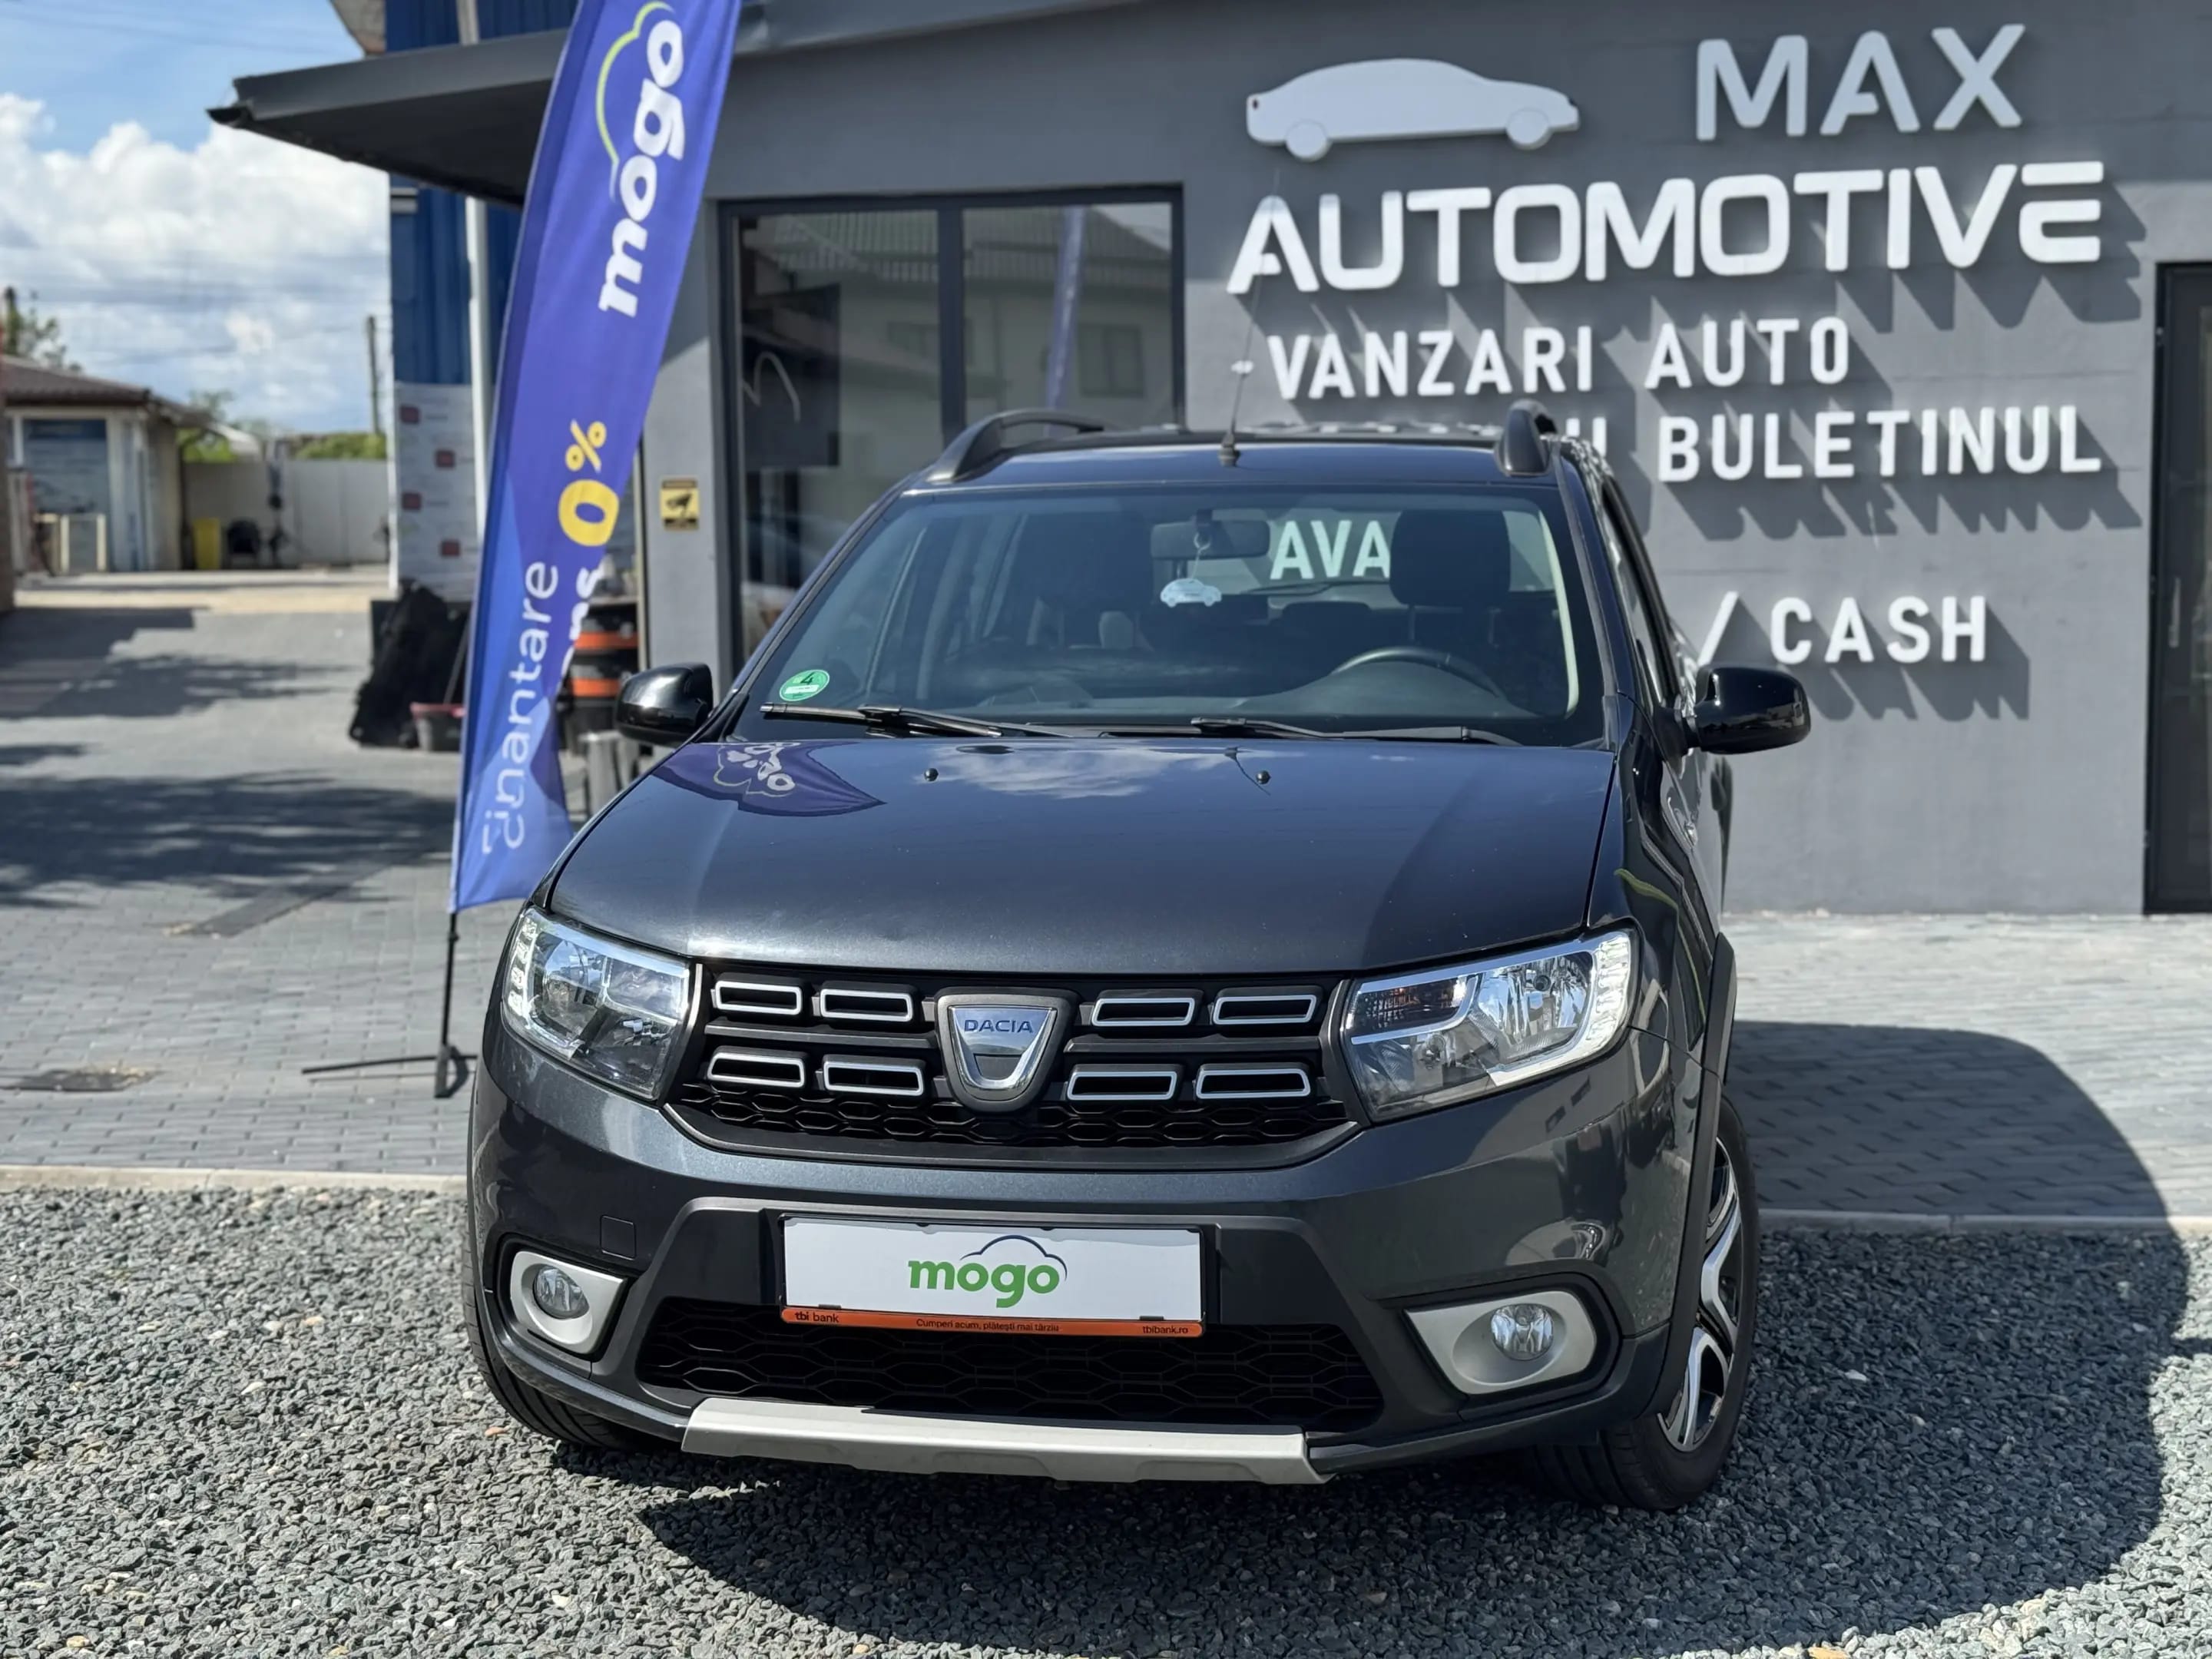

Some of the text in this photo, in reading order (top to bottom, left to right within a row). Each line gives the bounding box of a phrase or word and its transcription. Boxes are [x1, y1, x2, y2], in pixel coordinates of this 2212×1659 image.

[1697, 24, 2025, 141] MAX
[598, 20, 685, 318] mogo
[1227, 161, 2104, 294] AUTOMOTIVE
[1267, 316, 1849, 399] VANZARI AUTO
[558, 419, 619, 546] 0%
[1658, 405, 2101, 482] BULETINUL
[964, 1019, 1034, 1033] DACIA
[794, 1311, 839, 1323] tbi bank
[907, 1260, 1060, 1308] mogo
[916, 1318, 953, 1328] Cumperi
